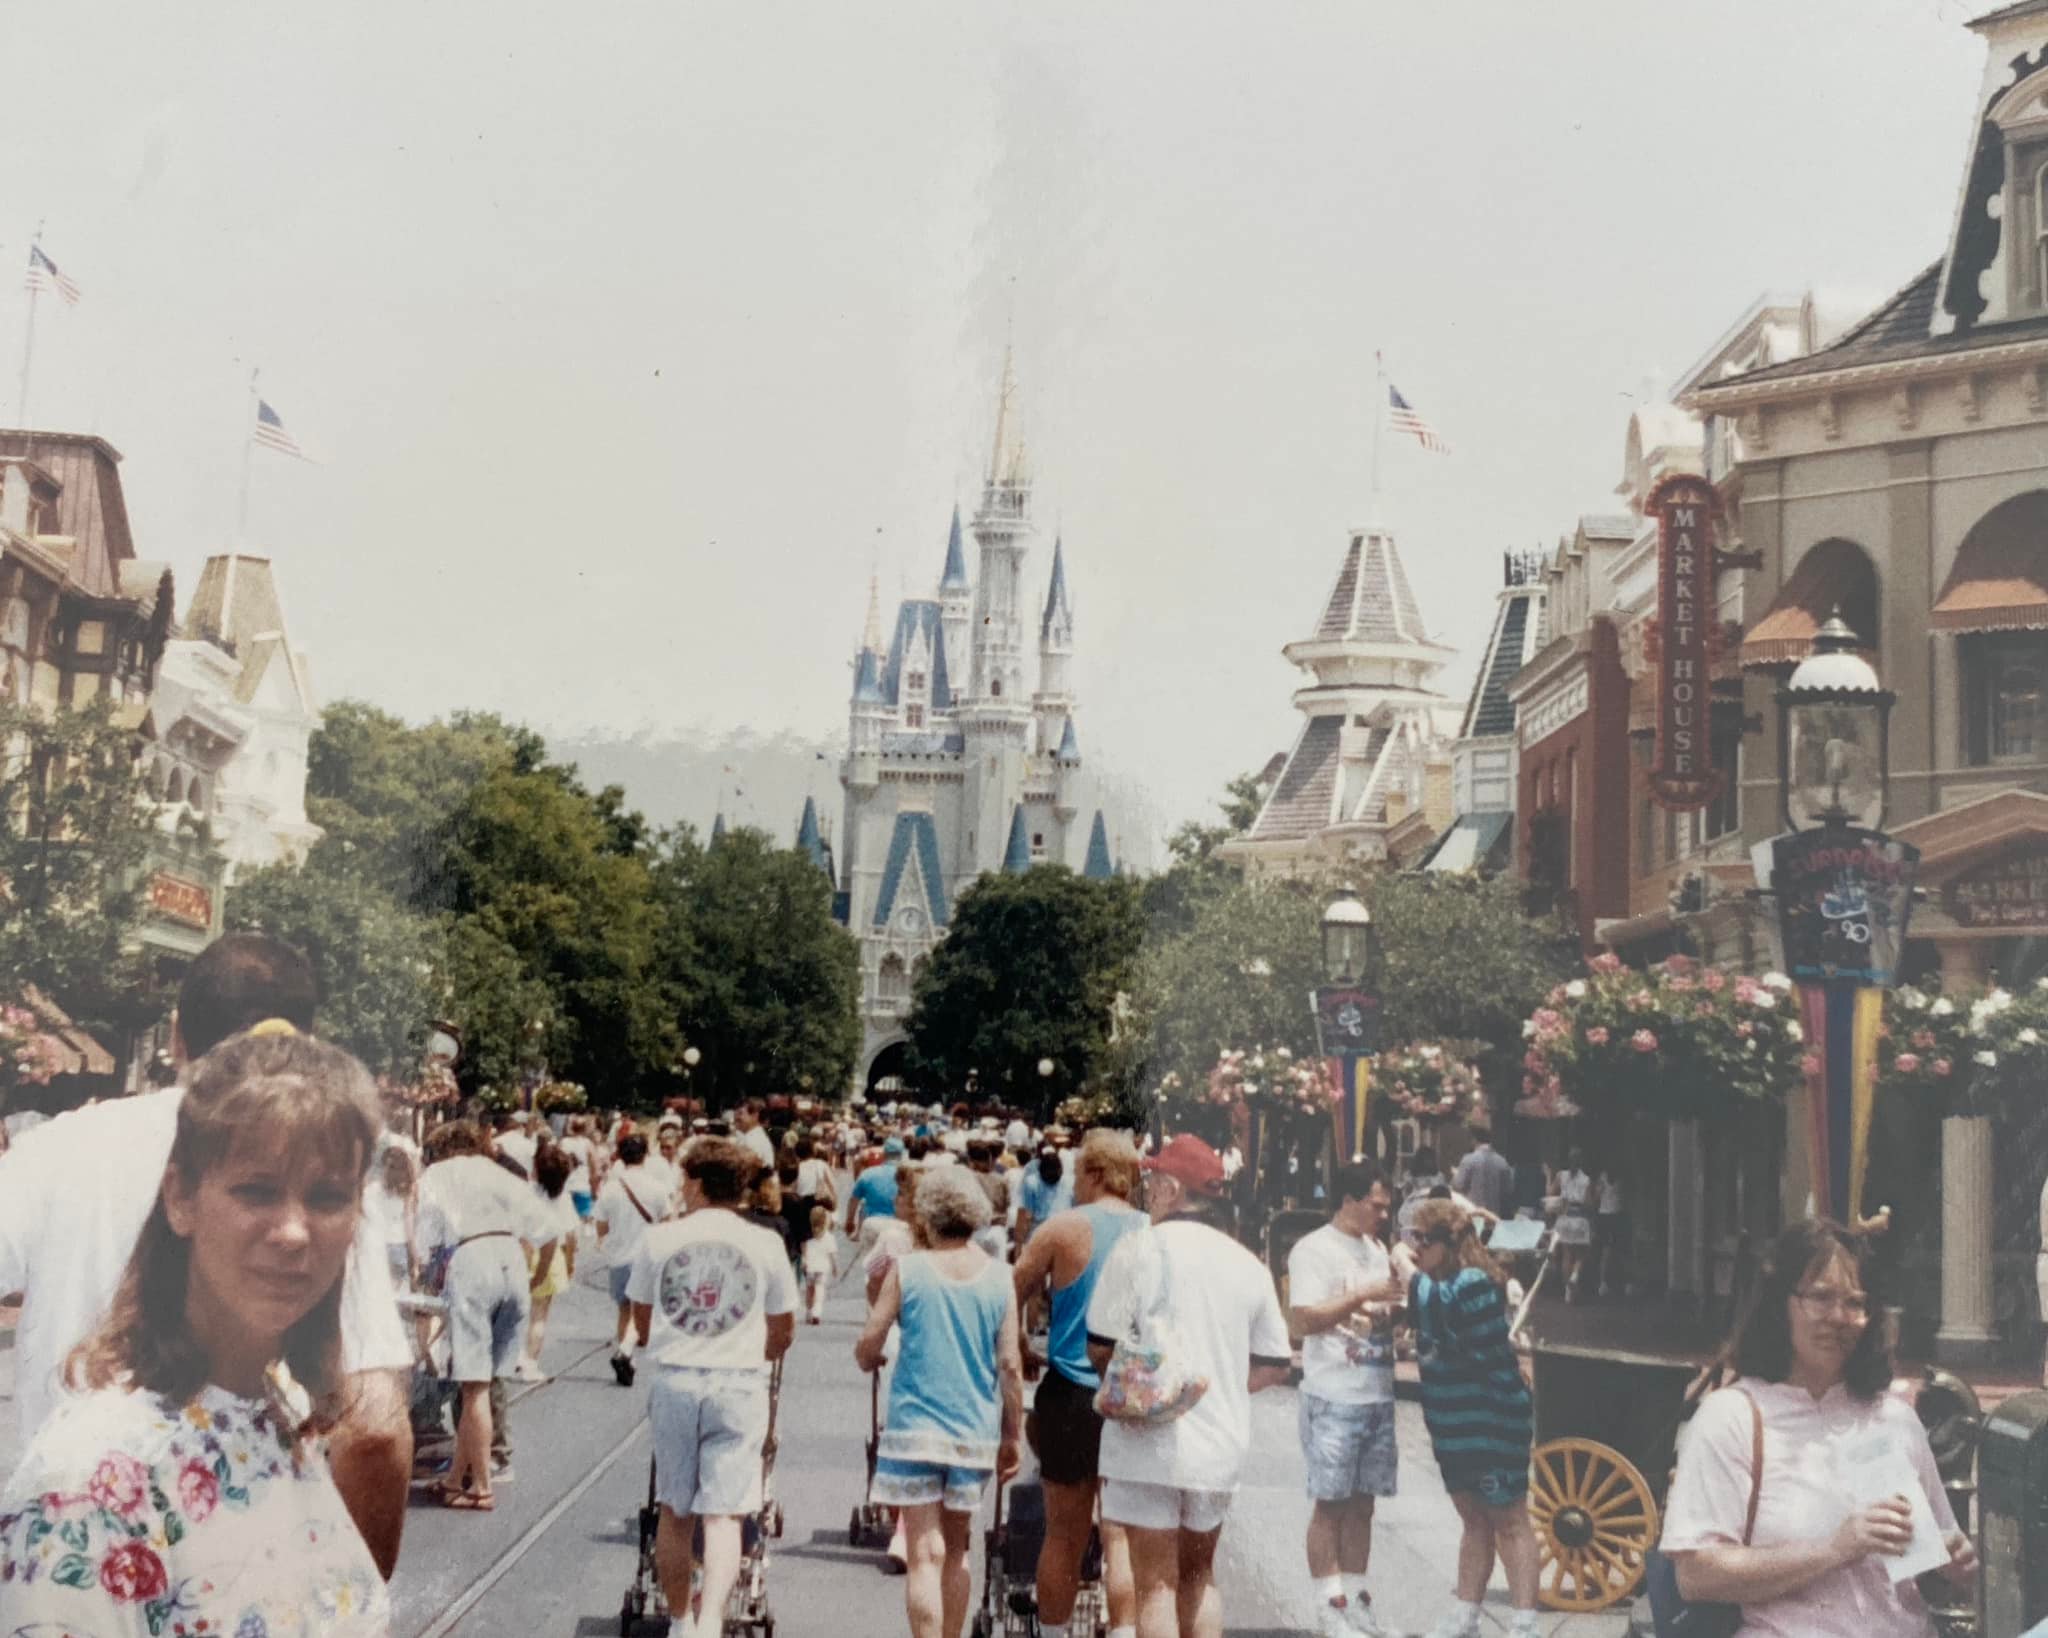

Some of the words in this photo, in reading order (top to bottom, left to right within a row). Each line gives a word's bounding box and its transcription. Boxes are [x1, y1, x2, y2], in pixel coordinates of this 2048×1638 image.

[1672, 508, 1696, 645] MARKET
[1672, 659, 1695, 775] HOUSE
[1840, 919, 1870, 943] 20
